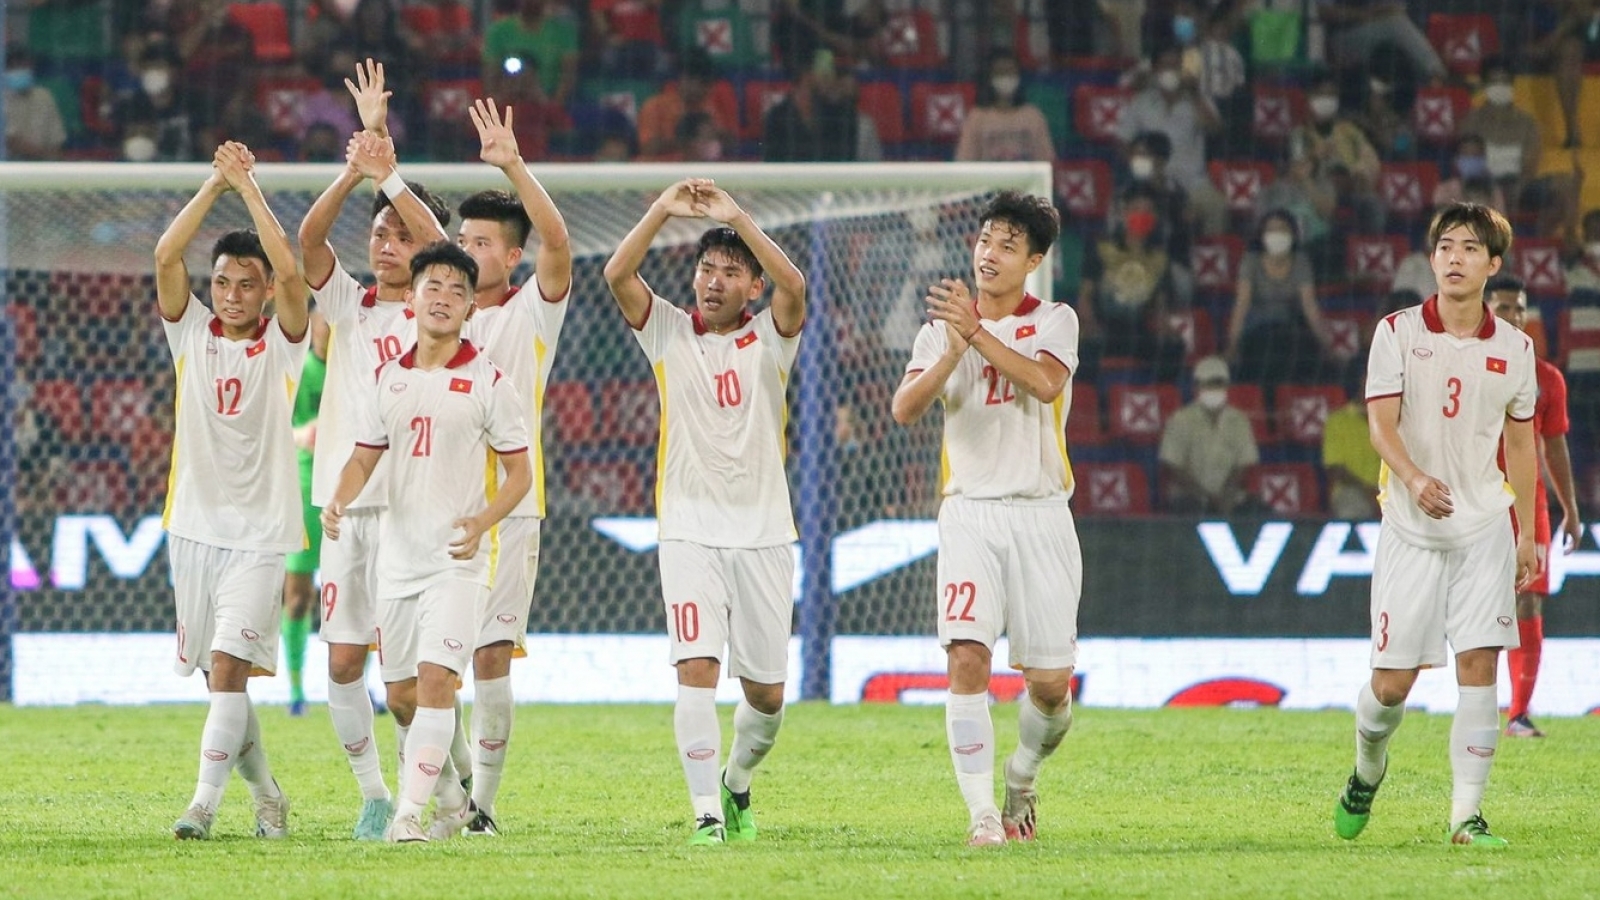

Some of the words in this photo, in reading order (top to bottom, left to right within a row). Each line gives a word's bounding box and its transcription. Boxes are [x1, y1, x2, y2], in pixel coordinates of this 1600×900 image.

[215, 378, 242, 415] 12
[714, 369, 742, 408] 10
[1442, 377, 1462, 418] 3
[411, 416, 431, 457] 21
[944, 581, 976, 621] 22
[672, 602, 699, 643] 10
[1377, 611, 1389, 652] 3
